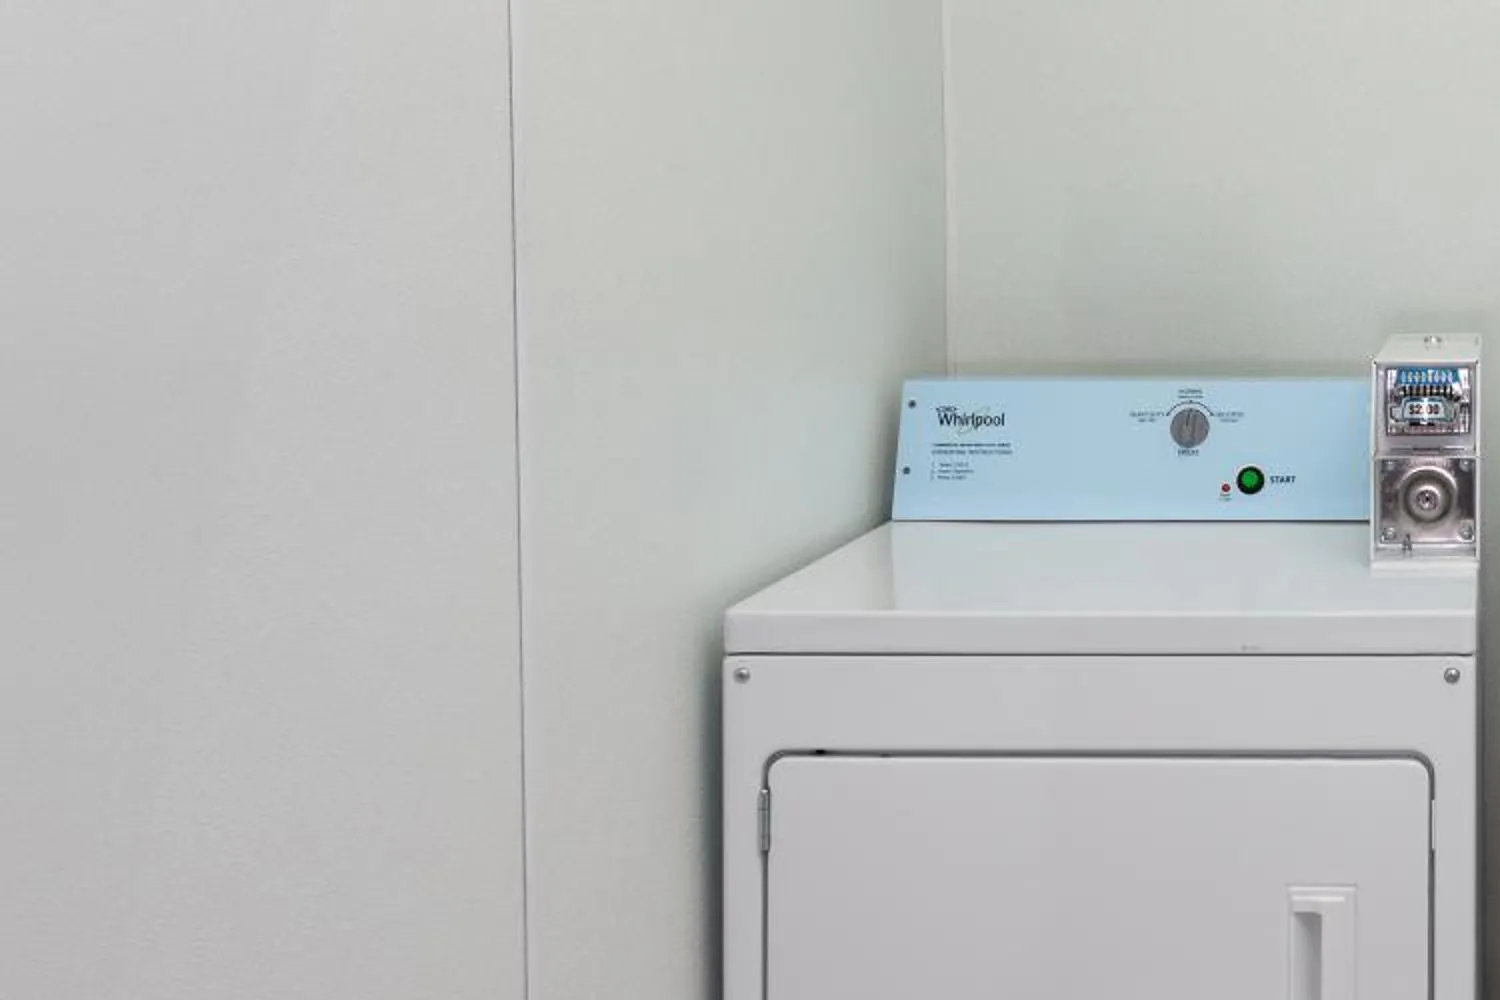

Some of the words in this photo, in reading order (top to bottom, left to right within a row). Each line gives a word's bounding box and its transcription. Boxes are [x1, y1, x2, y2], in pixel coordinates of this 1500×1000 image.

[1409, 403, 1441, 415] $200
[937, 411, 1005, 430] Whirlpool
[1269, 475, 1297, 485] START
